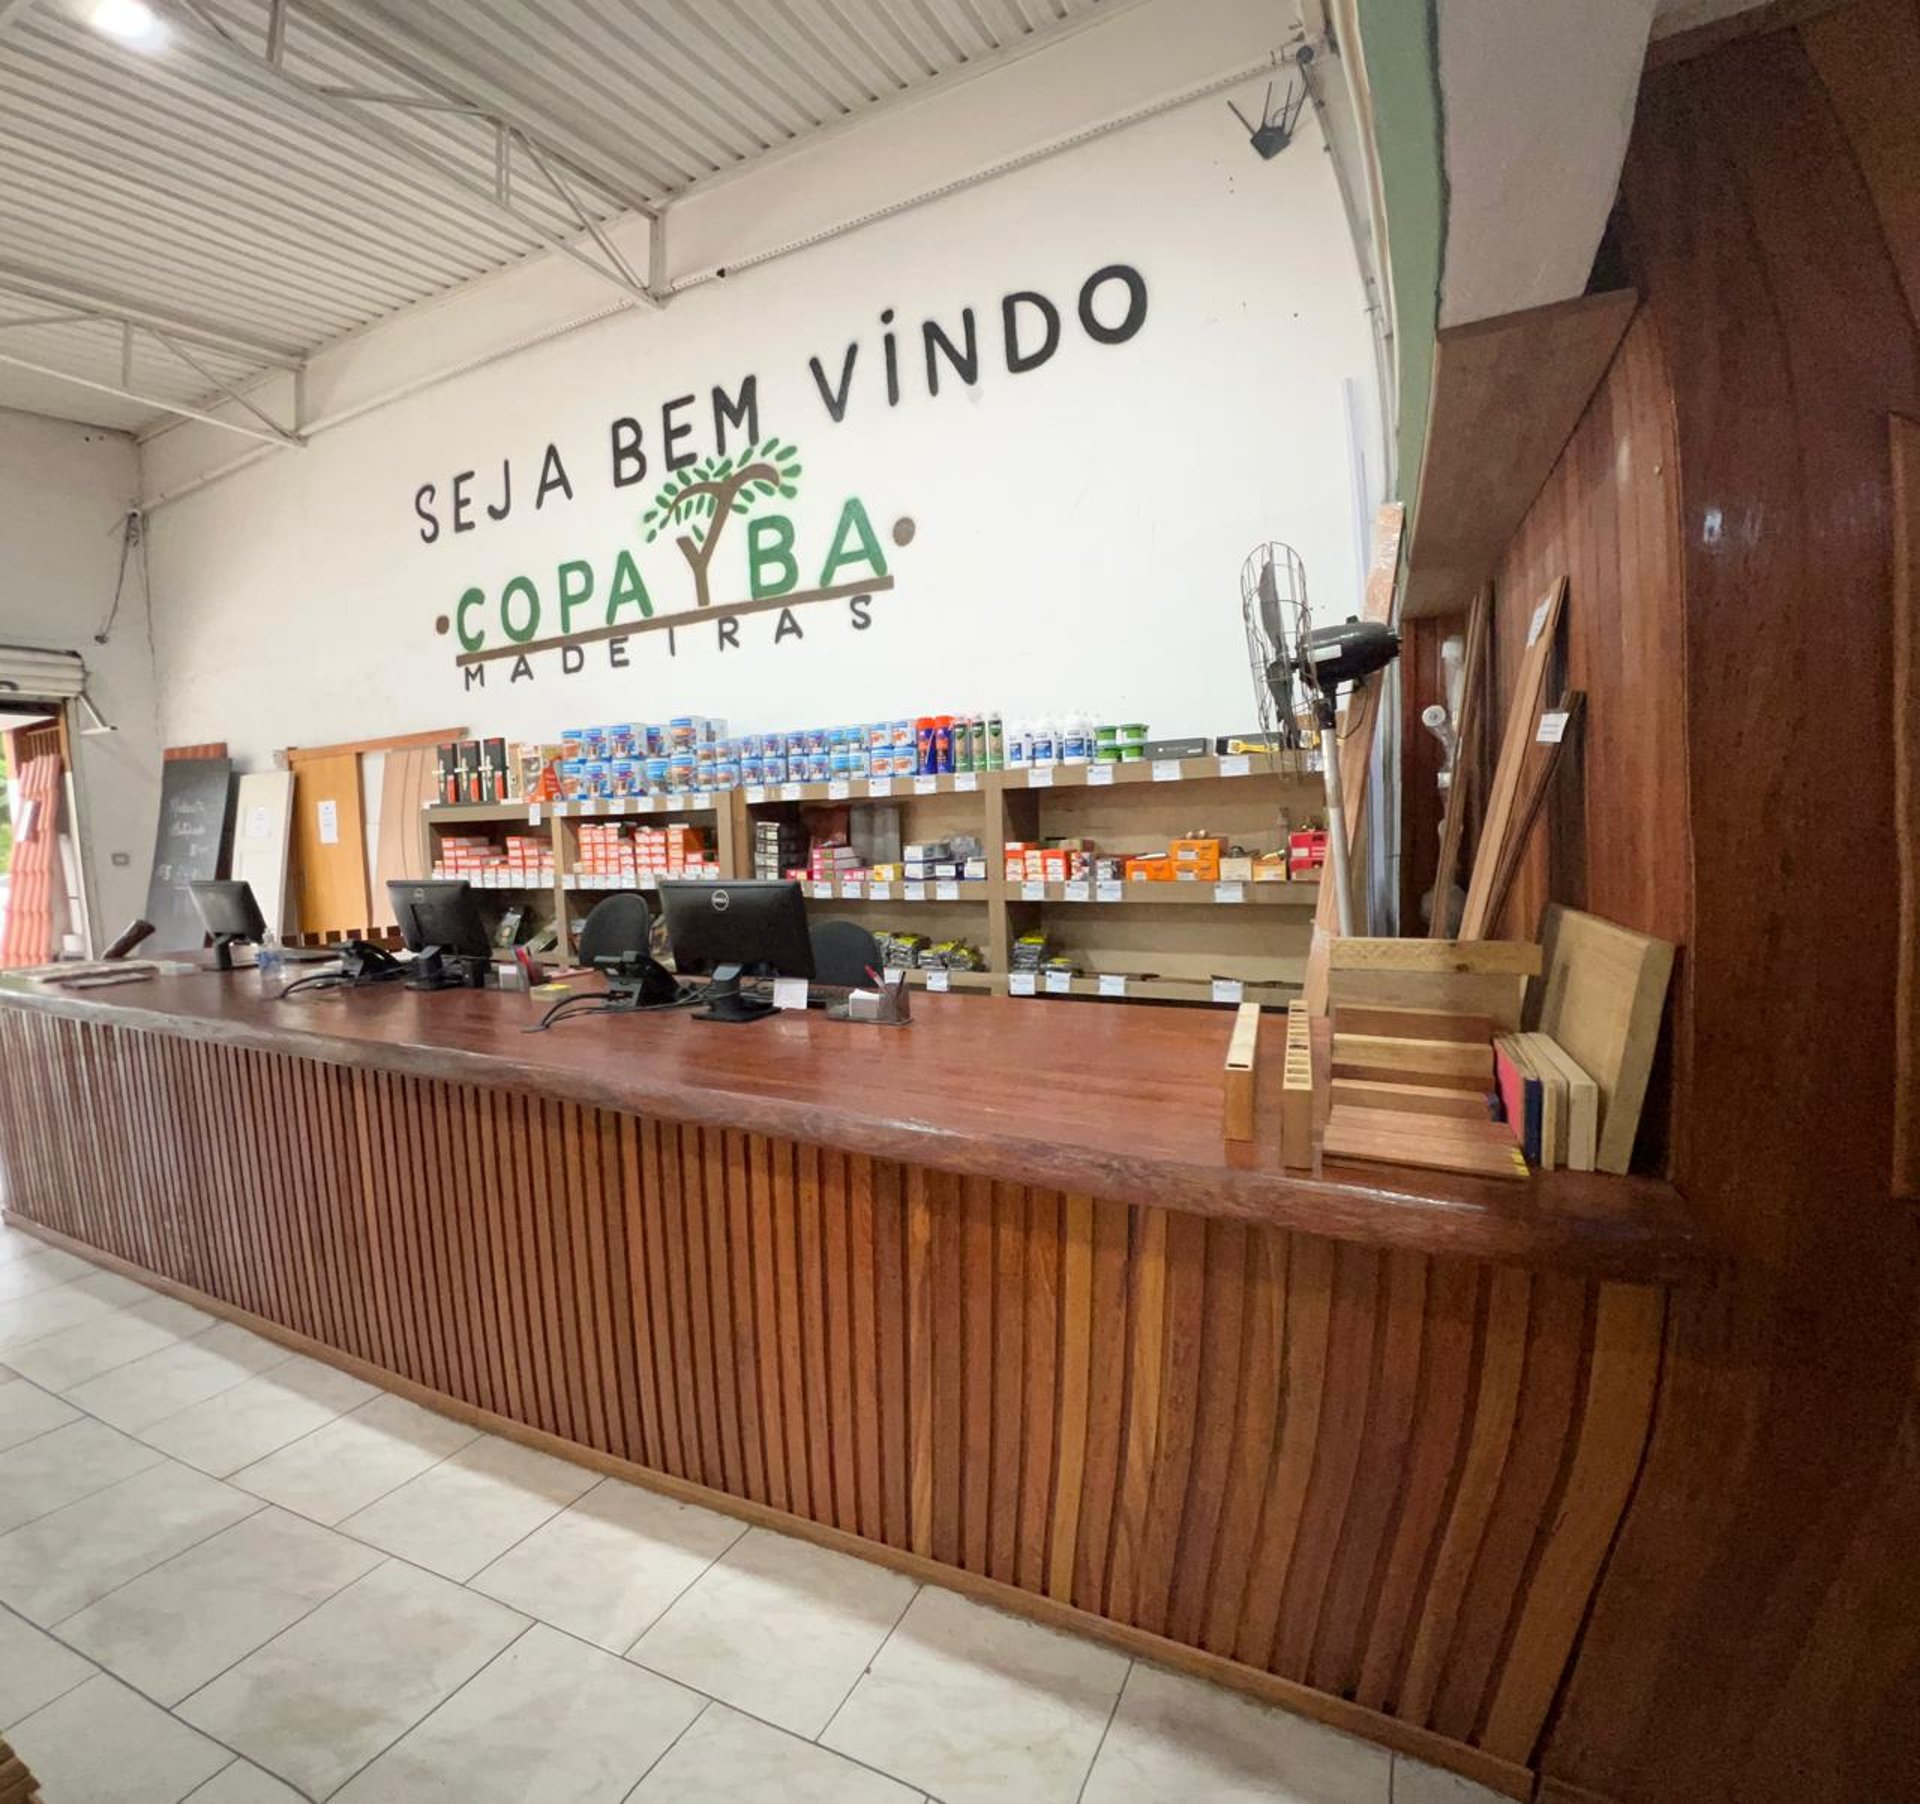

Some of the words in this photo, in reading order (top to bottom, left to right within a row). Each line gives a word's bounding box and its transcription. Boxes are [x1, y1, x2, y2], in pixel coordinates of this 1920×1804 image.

[414, 443, 573, 544] SEJA
[610, 374, 761, 489] BEM
[455, 497, 889, 652] COPAYBA
[463, 594, 872, 691] MADEIRAS
